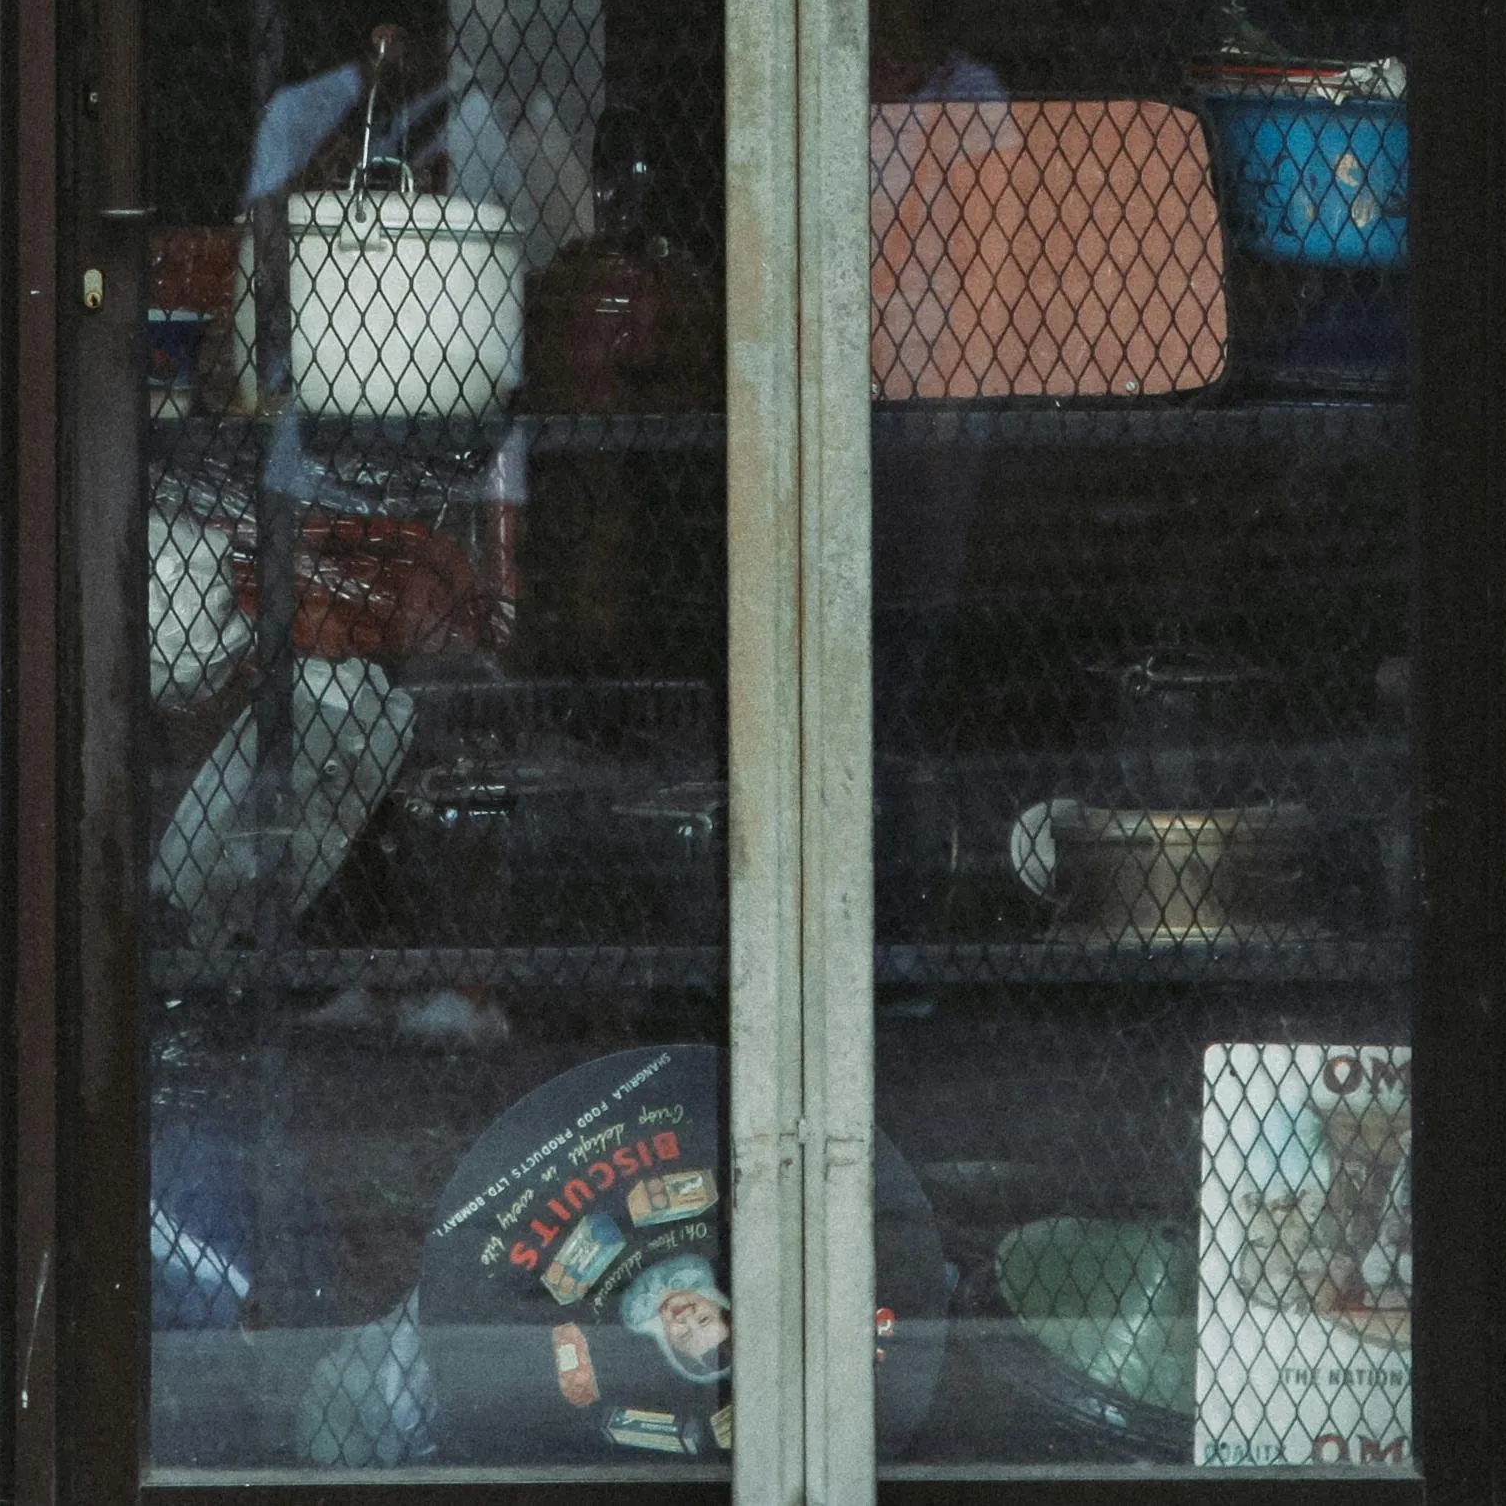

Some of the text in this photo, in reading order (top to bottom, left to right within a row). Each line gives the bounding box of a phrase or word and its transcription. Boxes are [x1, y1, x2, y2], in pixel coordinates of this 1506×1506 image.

[611, 1052, 672, 1100] SHANGRILA
[577, 1100, 610, 1129] FOOD
[511, 1127, 574, 1180] PRODUCTS
[567, 1121, 626, 1167] delight
[541, 1165, 560, 1183] in
[442, 1198, 486, 1234] BOMBAY
[496, 1188, 535, 1231] every
[510, 1131, 682, 1272] BISCUITS
[1282, 1368, 1321, 1386] THE
